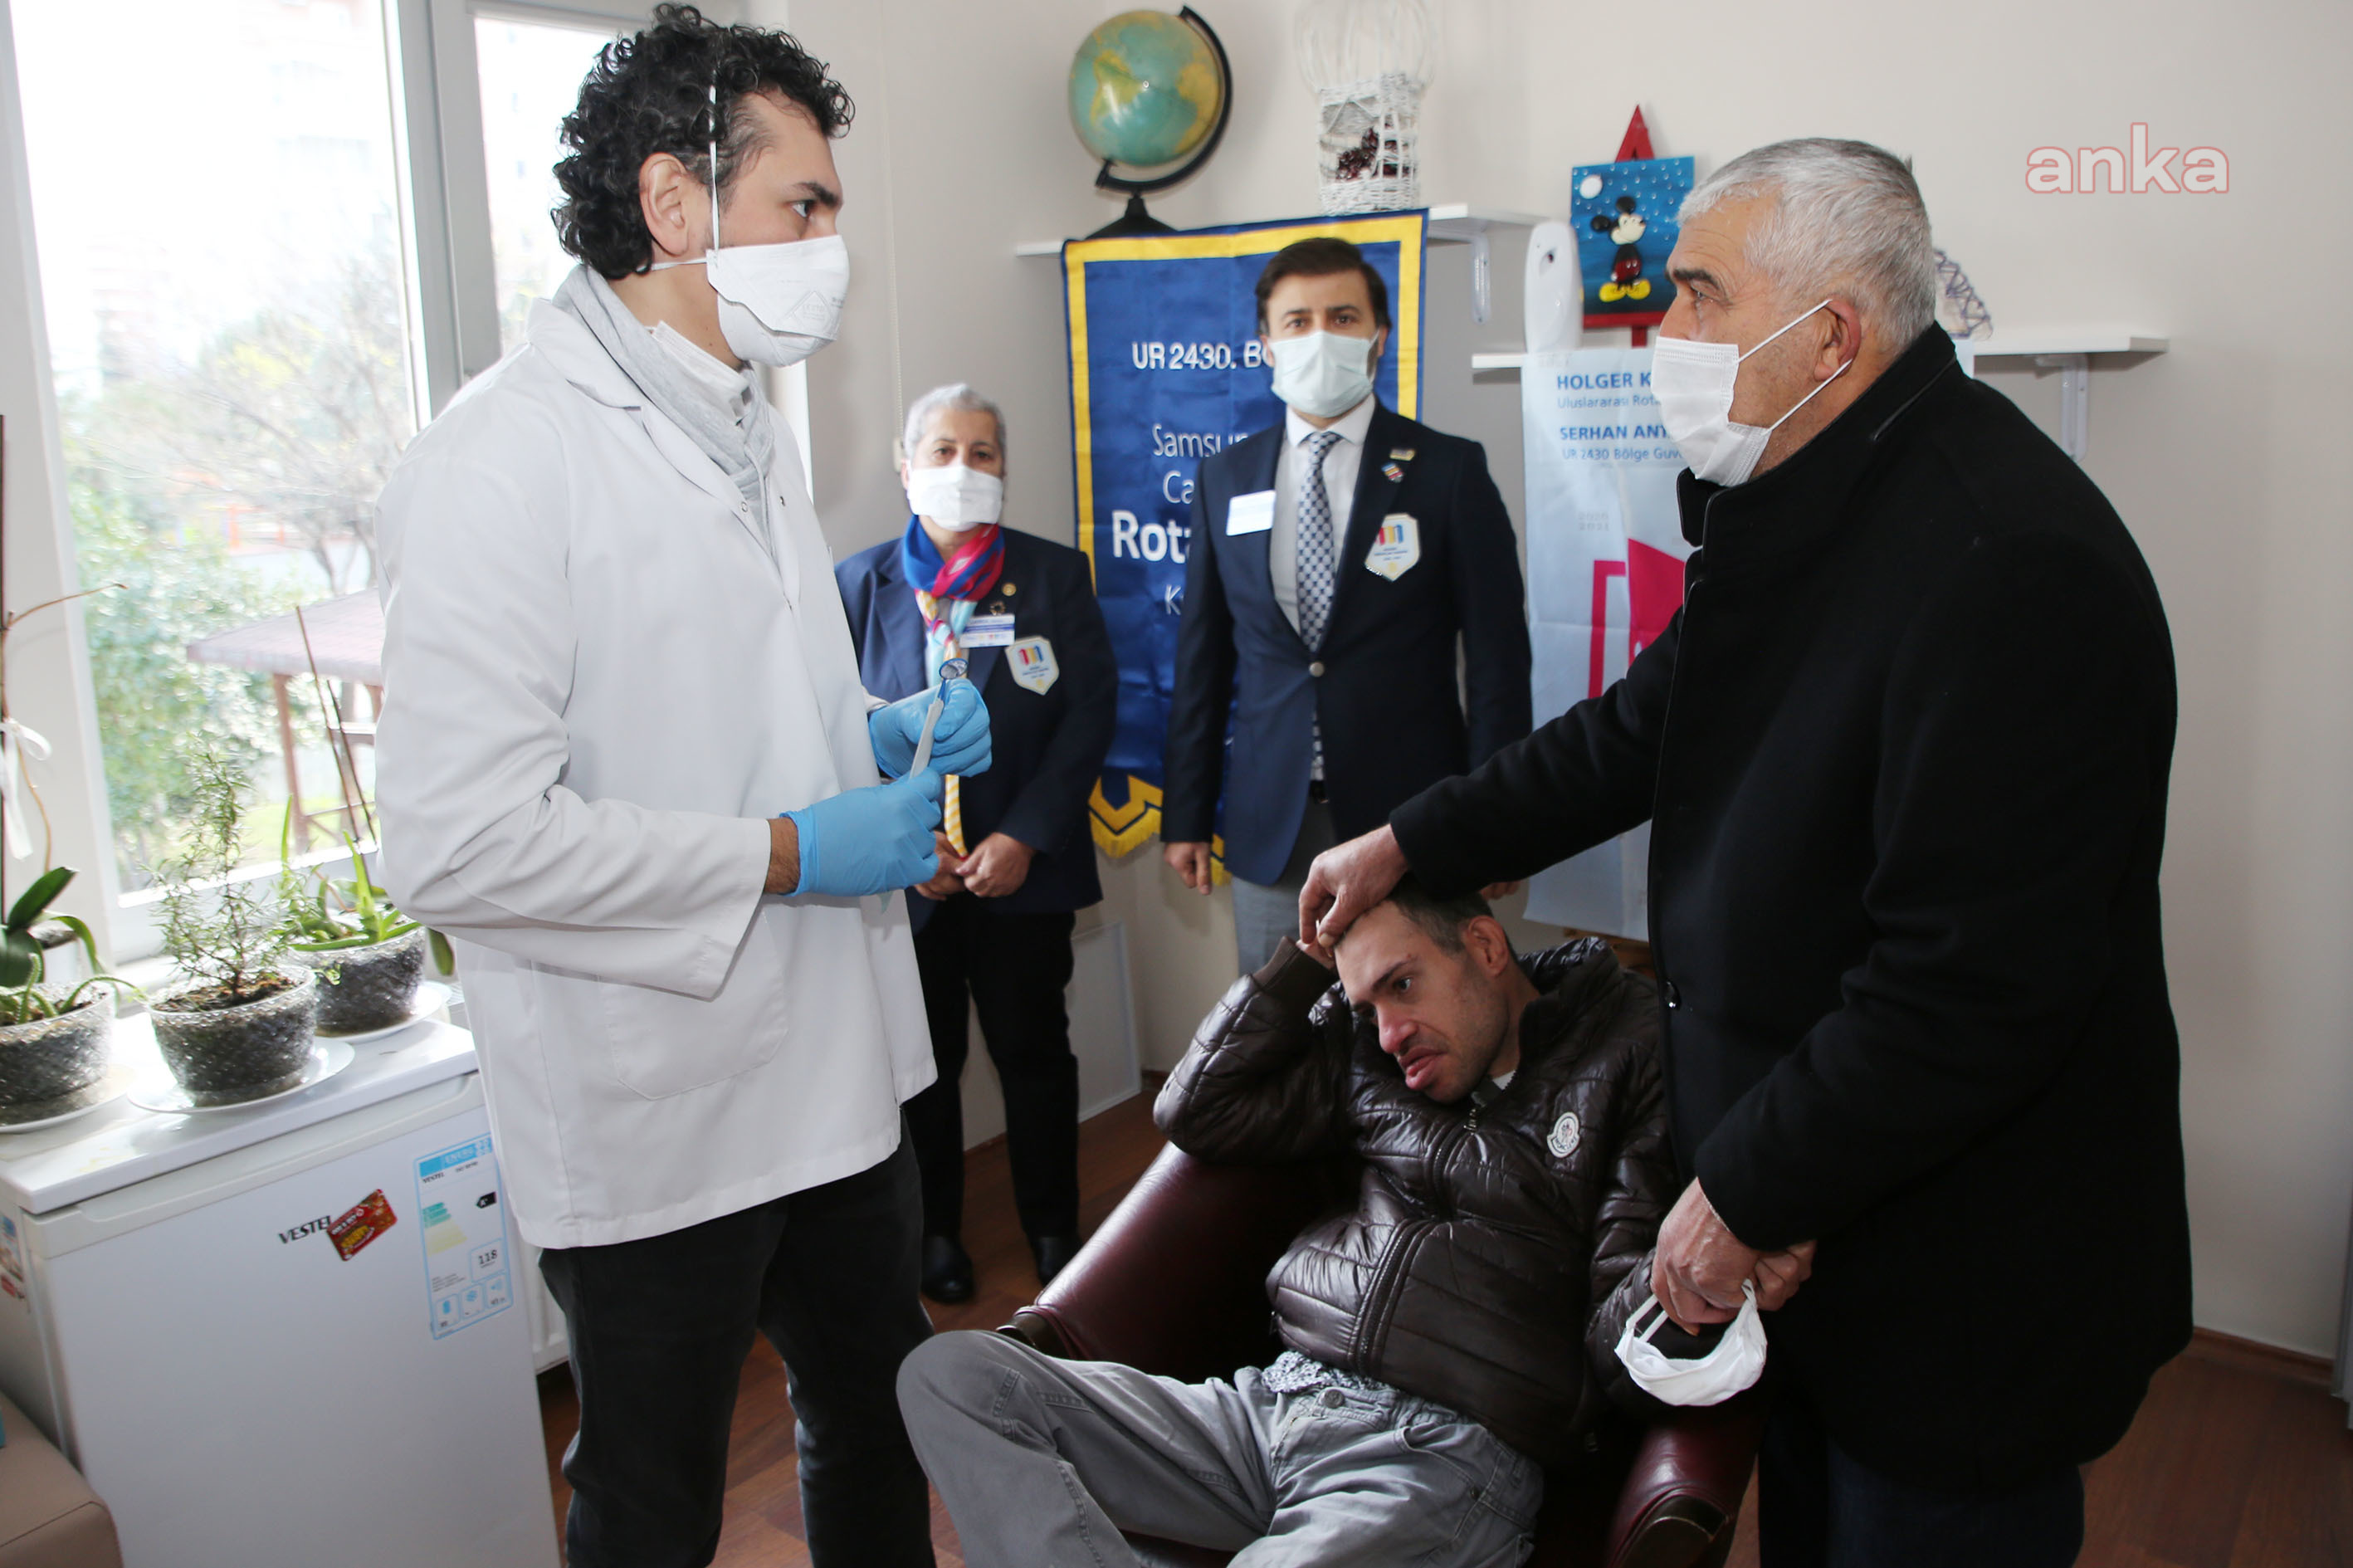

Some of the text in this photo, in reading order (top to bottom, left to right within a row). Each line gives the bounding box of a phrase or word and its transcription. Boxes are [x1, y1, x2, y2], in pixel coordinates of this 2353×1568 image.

[1131, 341, 1165, 370] UR
[1168, 342, 1237, 370] 2430.
[1557, 373, 1633, 390] HOLGER
[1632, 394, 1662, 407] Rot
[1560, 425, 1628, 441] SERHAN
[1580, 447, 1610, 461] 2430
